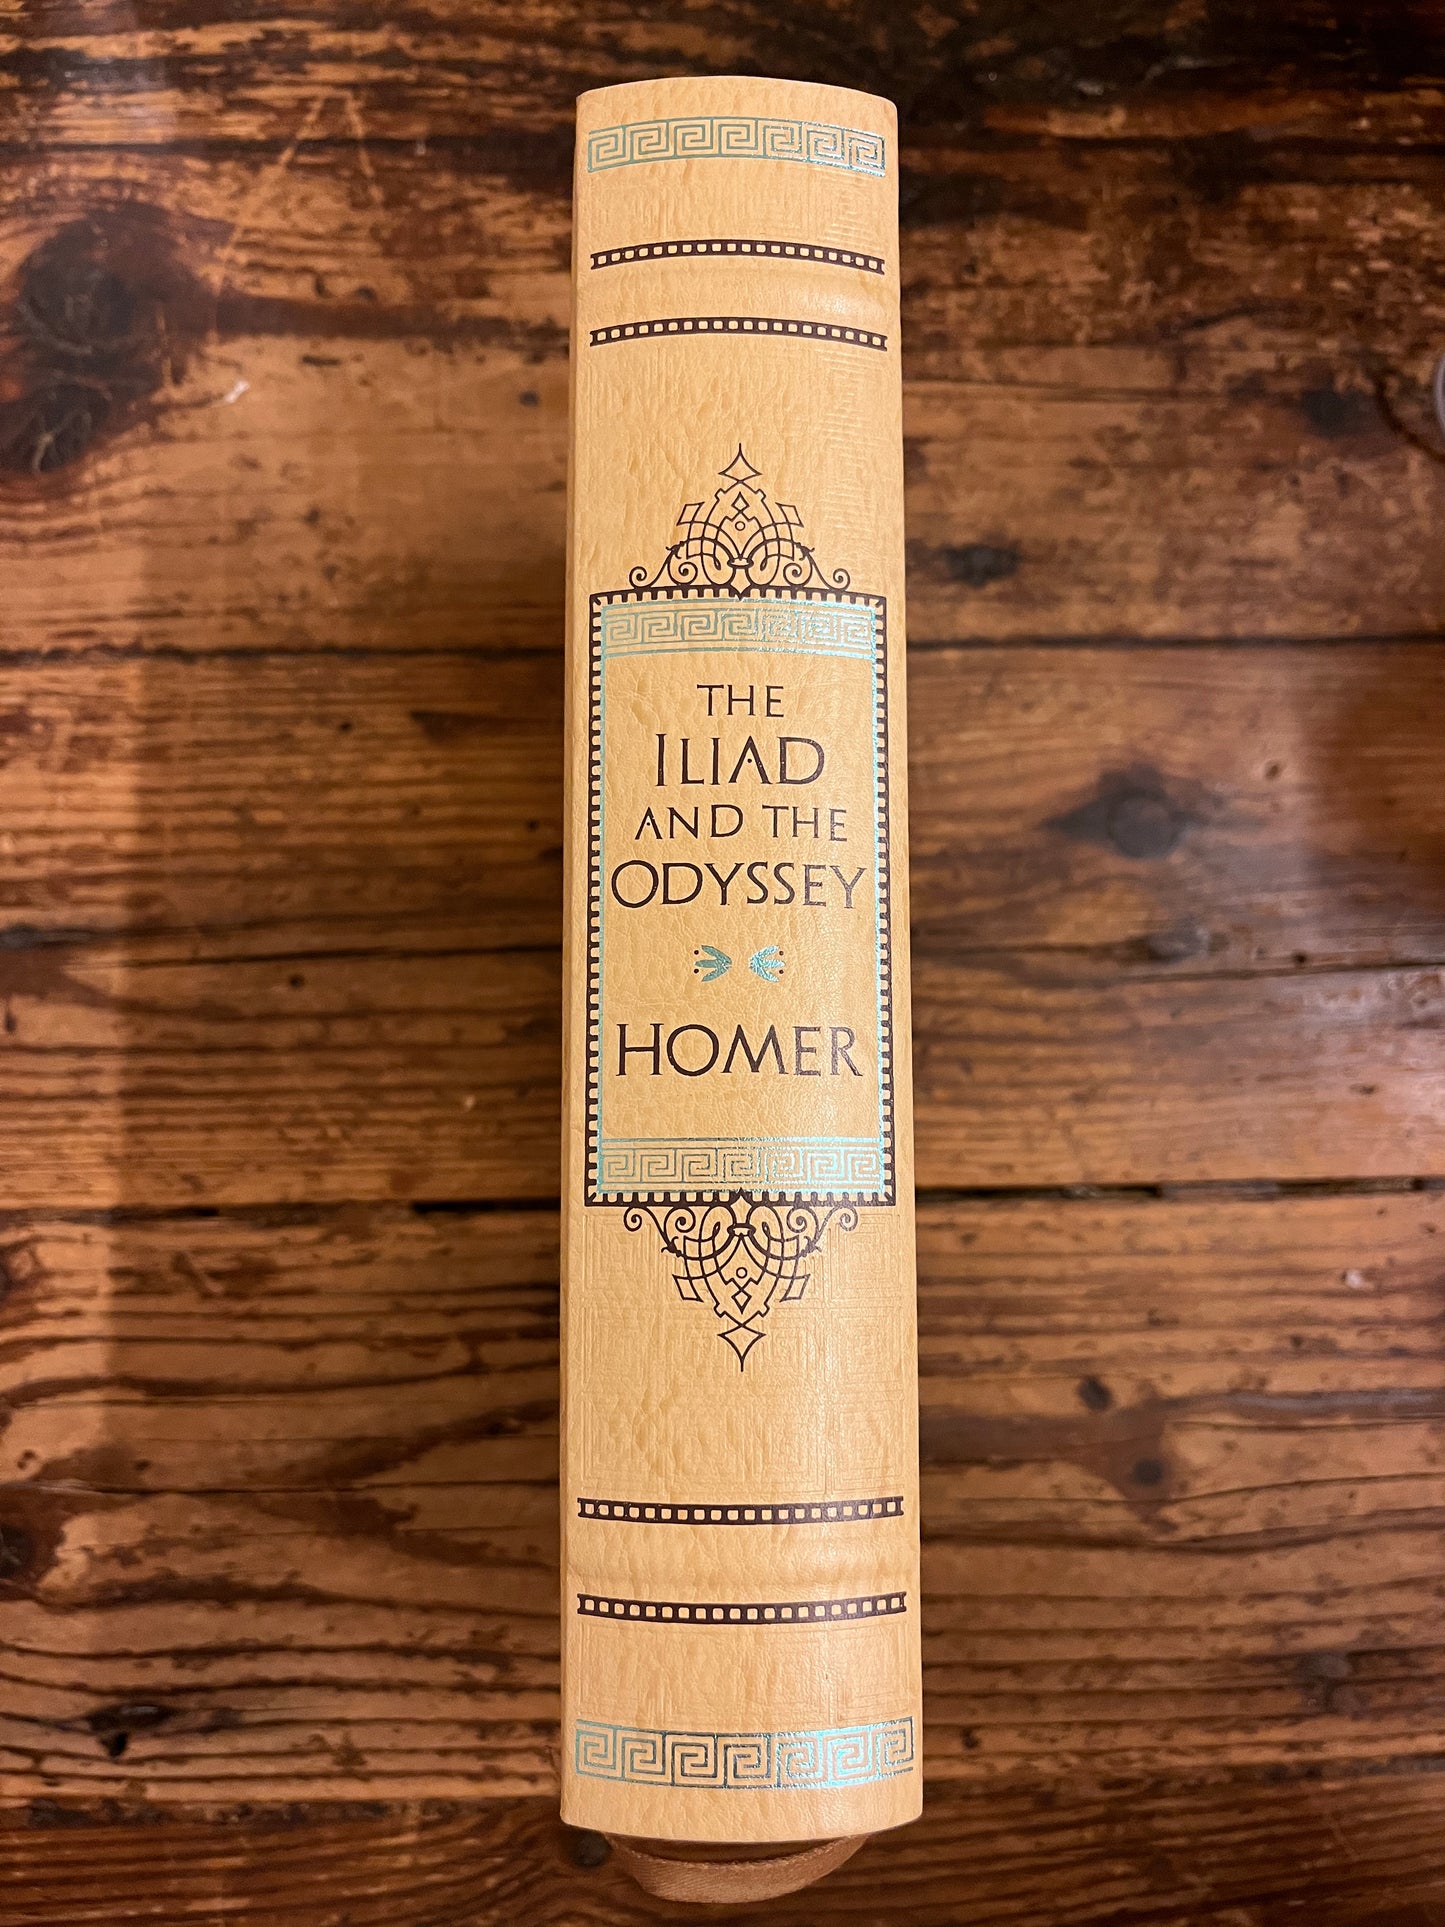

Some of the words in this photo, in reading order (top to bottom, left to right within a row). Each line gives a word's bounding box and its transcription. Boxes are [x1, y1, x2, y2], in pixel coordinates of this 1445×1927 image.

[697, 684, 785, 718] THE
[655, 733, 825, 787] ILIAD
[635, 804, 744, 841] AND
[762, 805, 848, 842] THE
[611, 859, 867, 909] ODYSSEY
[616, 1023, 863, 1078] HOMER
